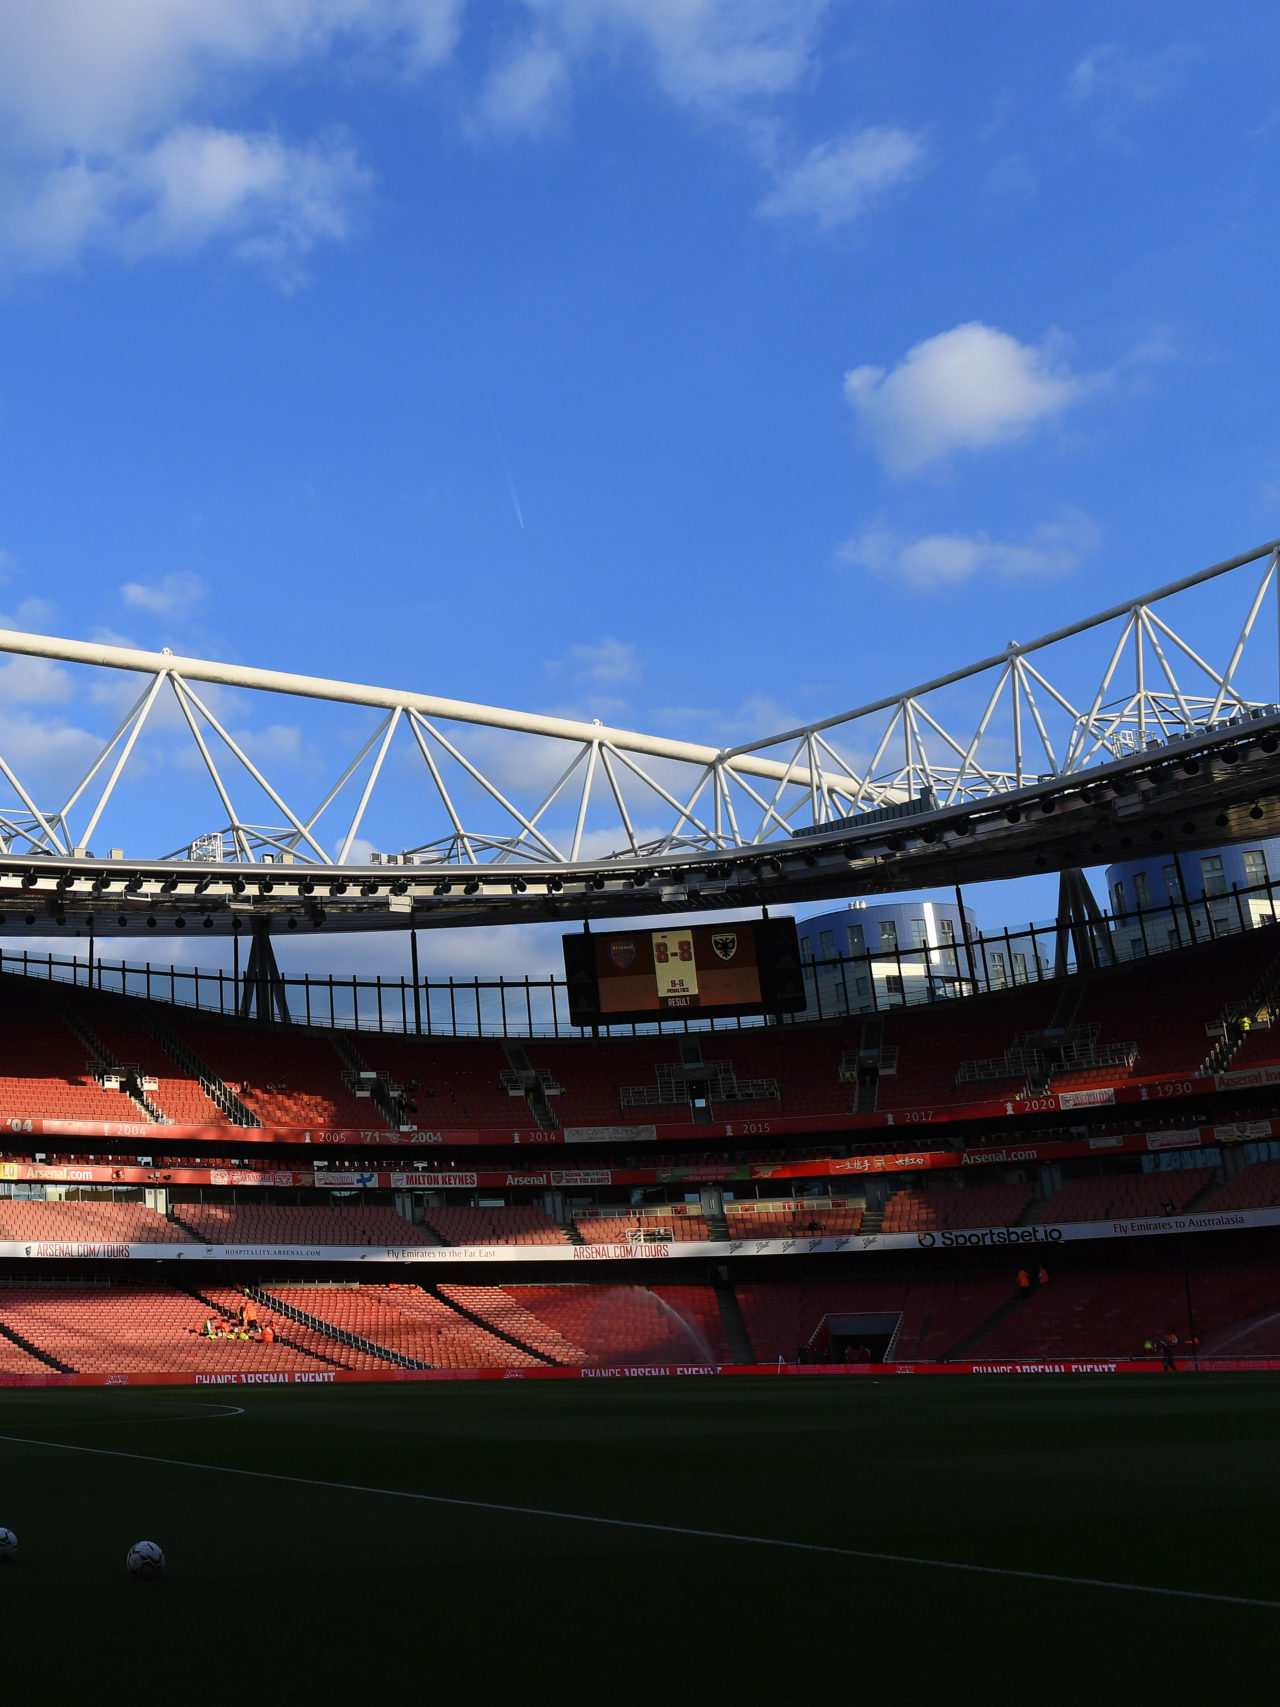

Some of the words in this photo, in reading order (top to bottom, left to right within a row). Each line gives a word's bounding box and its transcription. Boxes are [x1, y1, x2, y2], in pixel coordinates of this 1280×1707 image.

[668, 997, 690, 1007] RESULT
[1218, 1070, 1261, 1089] Arsenal
[1157, 1081, 1192, 1097] 1930
[1023, 1098, 1056, 1111] 2020
[905, 1110, 934, 1123] 2017
[116, 1125, 146, 1136] 2004
[743, 1122, 770, 1134] 2015
[318, 1131, 346, 1143] 2005
[410, 1132, 443, 1143] 2004
[529, 1131, 556, 1142] 2014
[961, 1149, 1038, 1165] Arsenal.com
[26, 1166, 93, 1180] Arsenal.com
[506, 1173, 547, 1186] Arsenal
[405, 1174, 440, 1186] MILTON
[441, 1174, 476, 1186] KEYNES
[1113, 1223, 1128, 1234] Fly
[1131, 1220, 1173, 1232] Emirates
[1175, 1219, 1186, 1229] to
[1188, 1213, 1245, 1228] Australasia
[941, 1226, 1062, 1247] Sportsbet.io
[36, 1243, 130, 1258] ARSENAL.COM/TOURS
[224, 1248, 321, 1257] HOSPITALITY.ARSENAL.COM
[387, 1249, 400, 1260] Fly
[401, 1248, 436, 1258] Emirates
[438, 1249, 447, 1258] to
[449, 1249, 462, 1258] the
[464, 1249, 476, 1258] Far
[478, 1248, 496, 1258] East
[573, 1244, 669, 1259] ARSENAL.COM/TOURS
